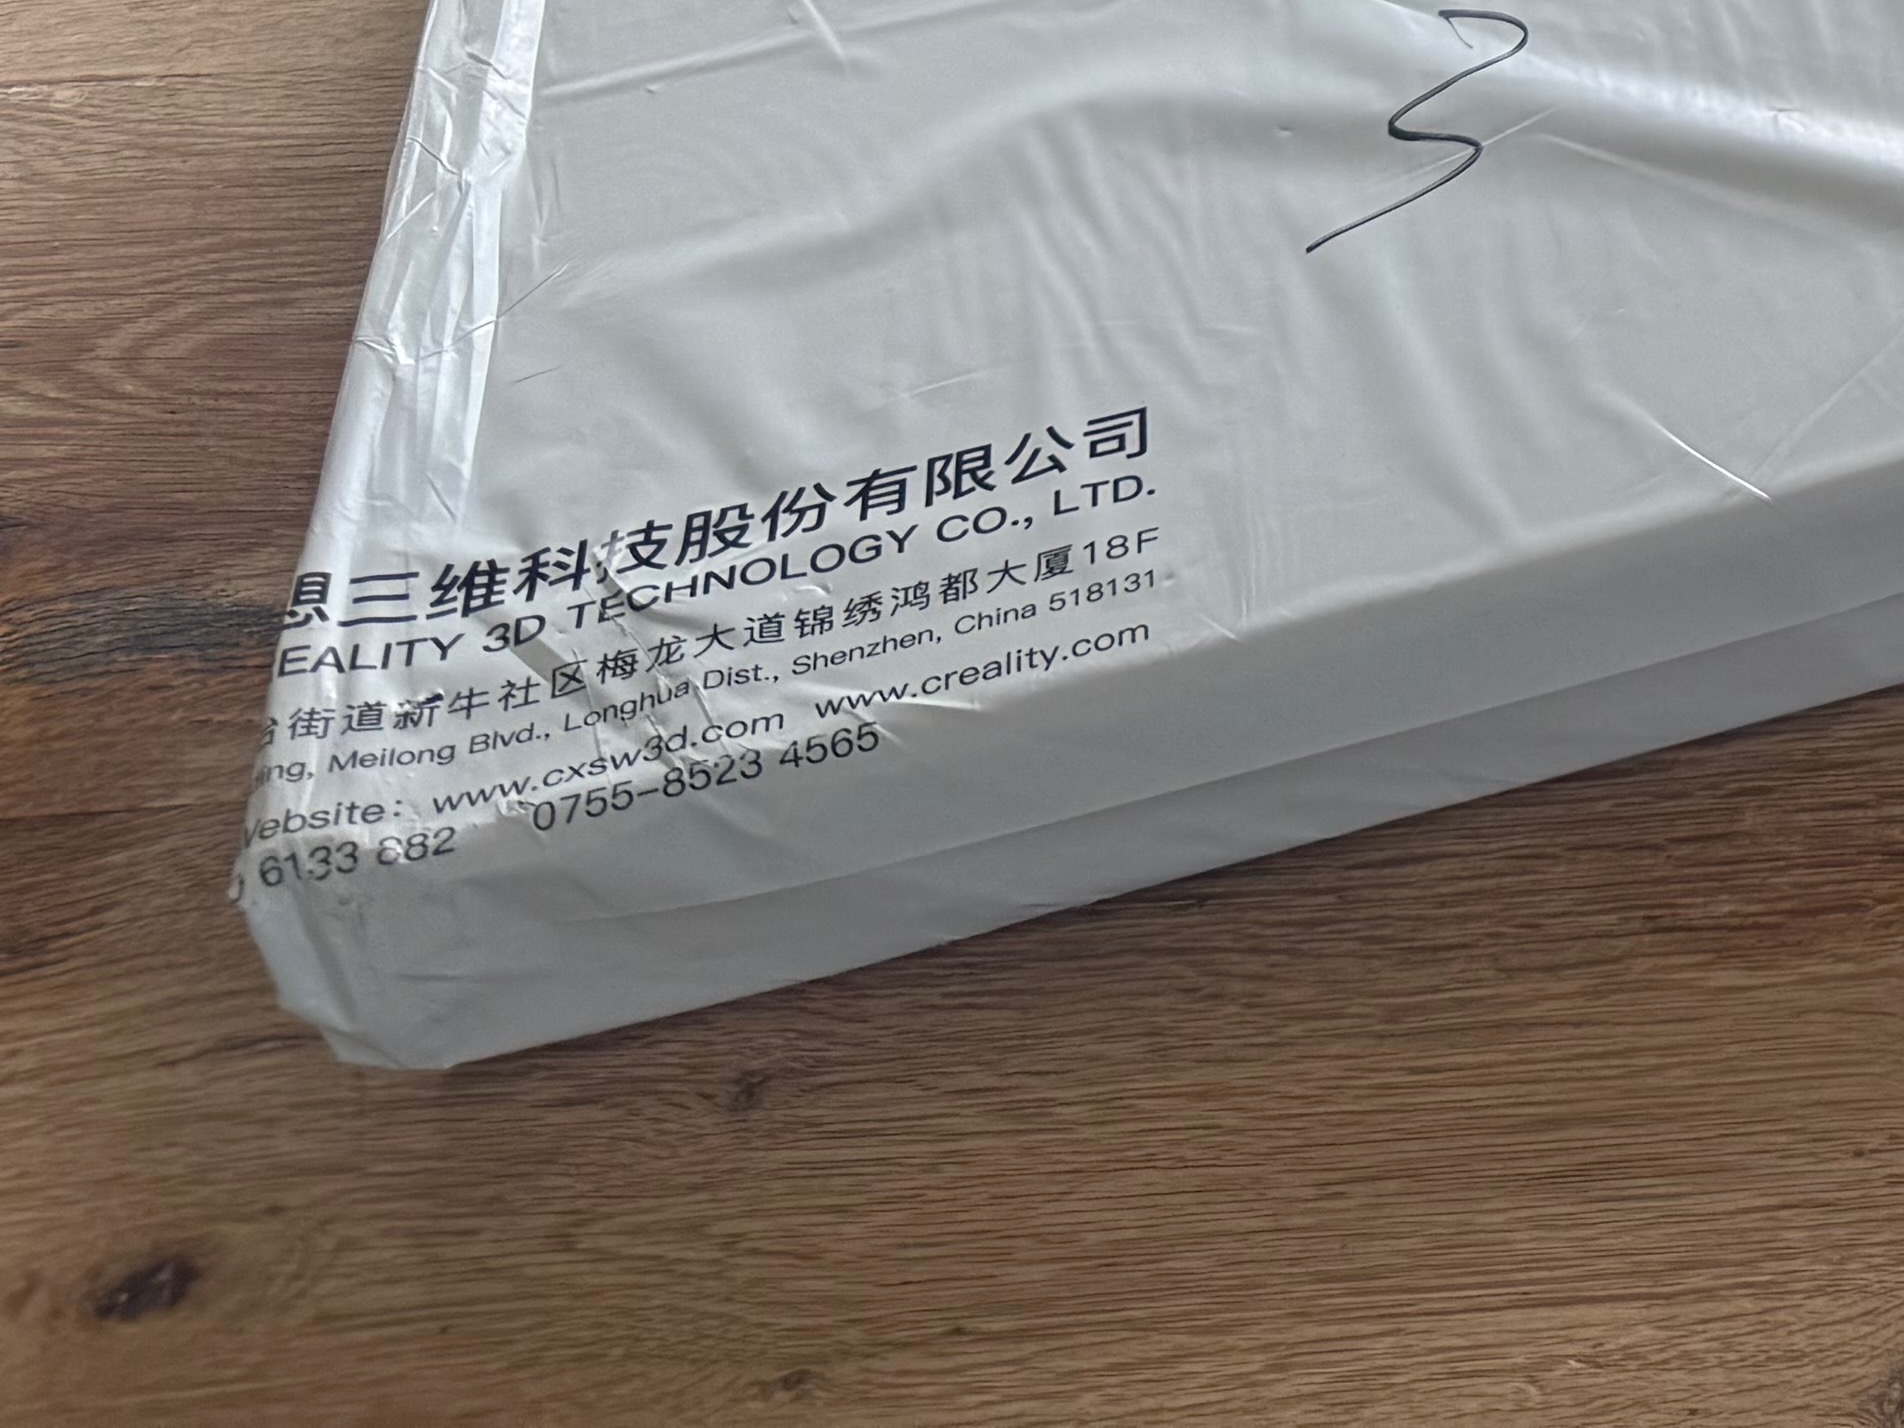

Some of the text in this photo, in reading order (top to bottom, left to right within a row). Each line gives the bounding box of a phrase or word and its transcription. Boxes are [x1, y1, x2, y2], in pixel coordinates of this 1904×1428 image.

[277, 475, 1157, 678] EALITY 3D TECHNOLOGY CO., LTD.
[255, 569, 1156, 789] ing, Meilong Blvd., Longhua Dist., Shenzhen, China 518131
[432, 711, 785, 814] www.cxsw3d.com
[815, 622, 1151, 719] www.creality.com
[258, 841, 359, 887] 6133
[779, 721, 880, 769] 4565
